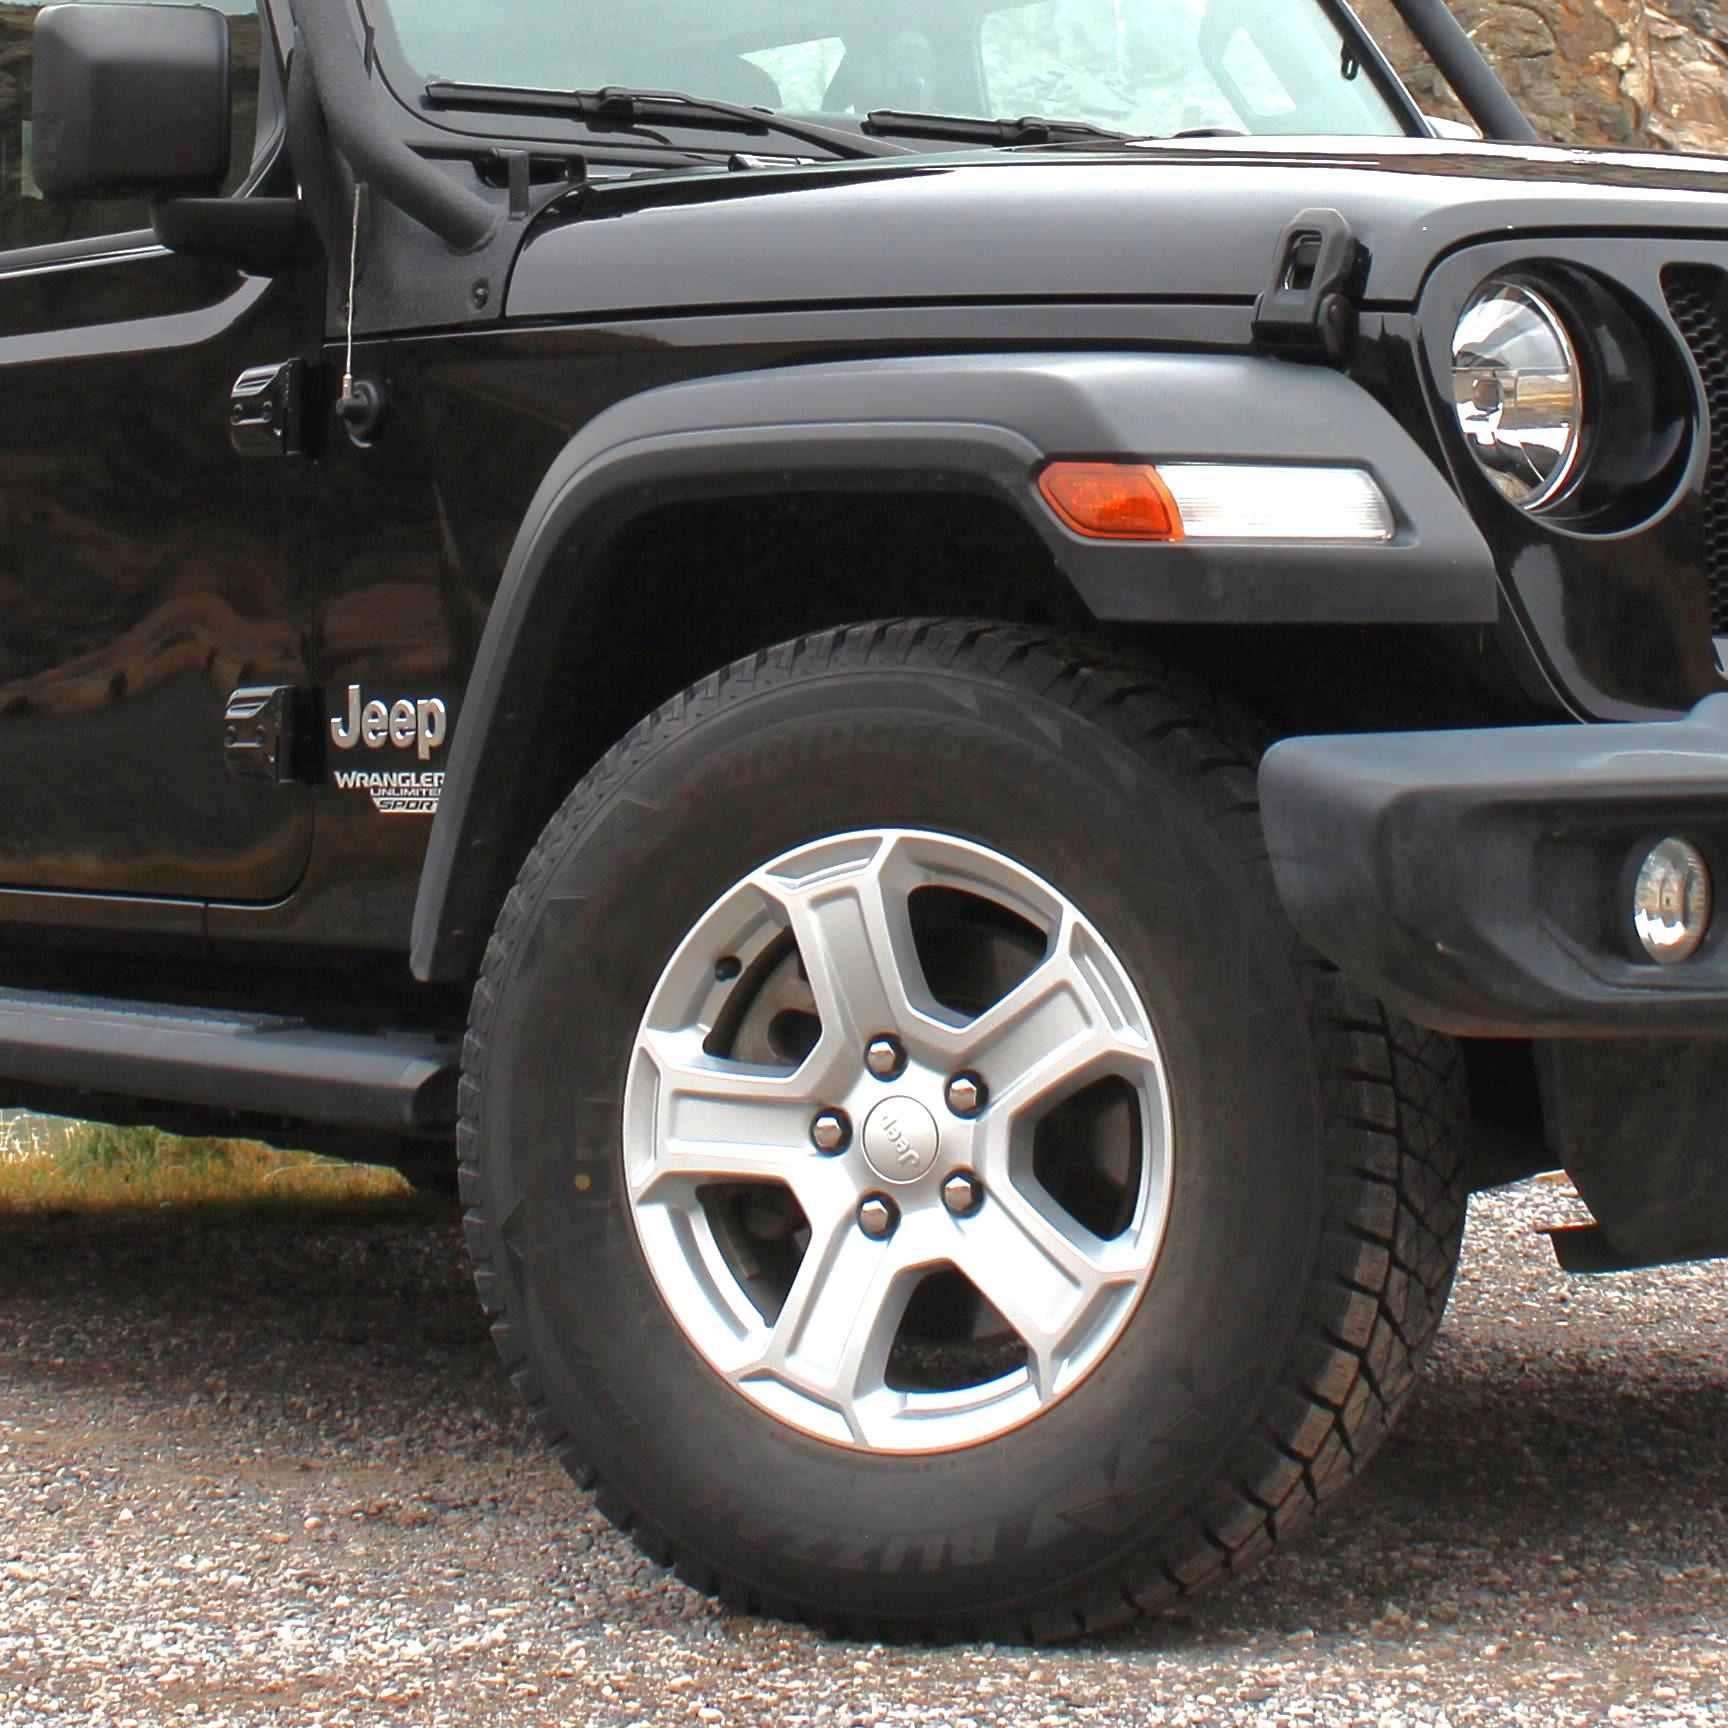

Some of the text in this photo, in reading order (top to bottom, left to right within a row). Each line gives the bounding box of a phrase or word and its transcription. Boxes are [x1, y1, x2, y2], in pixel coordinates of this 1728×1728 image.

[330, 684, 448, 761] Jeep
[334, 770, 446, 789] WRANGLER
[370, 788, 442, 797] UNLIMITE
[378, 799, 439, 811] SPOR
